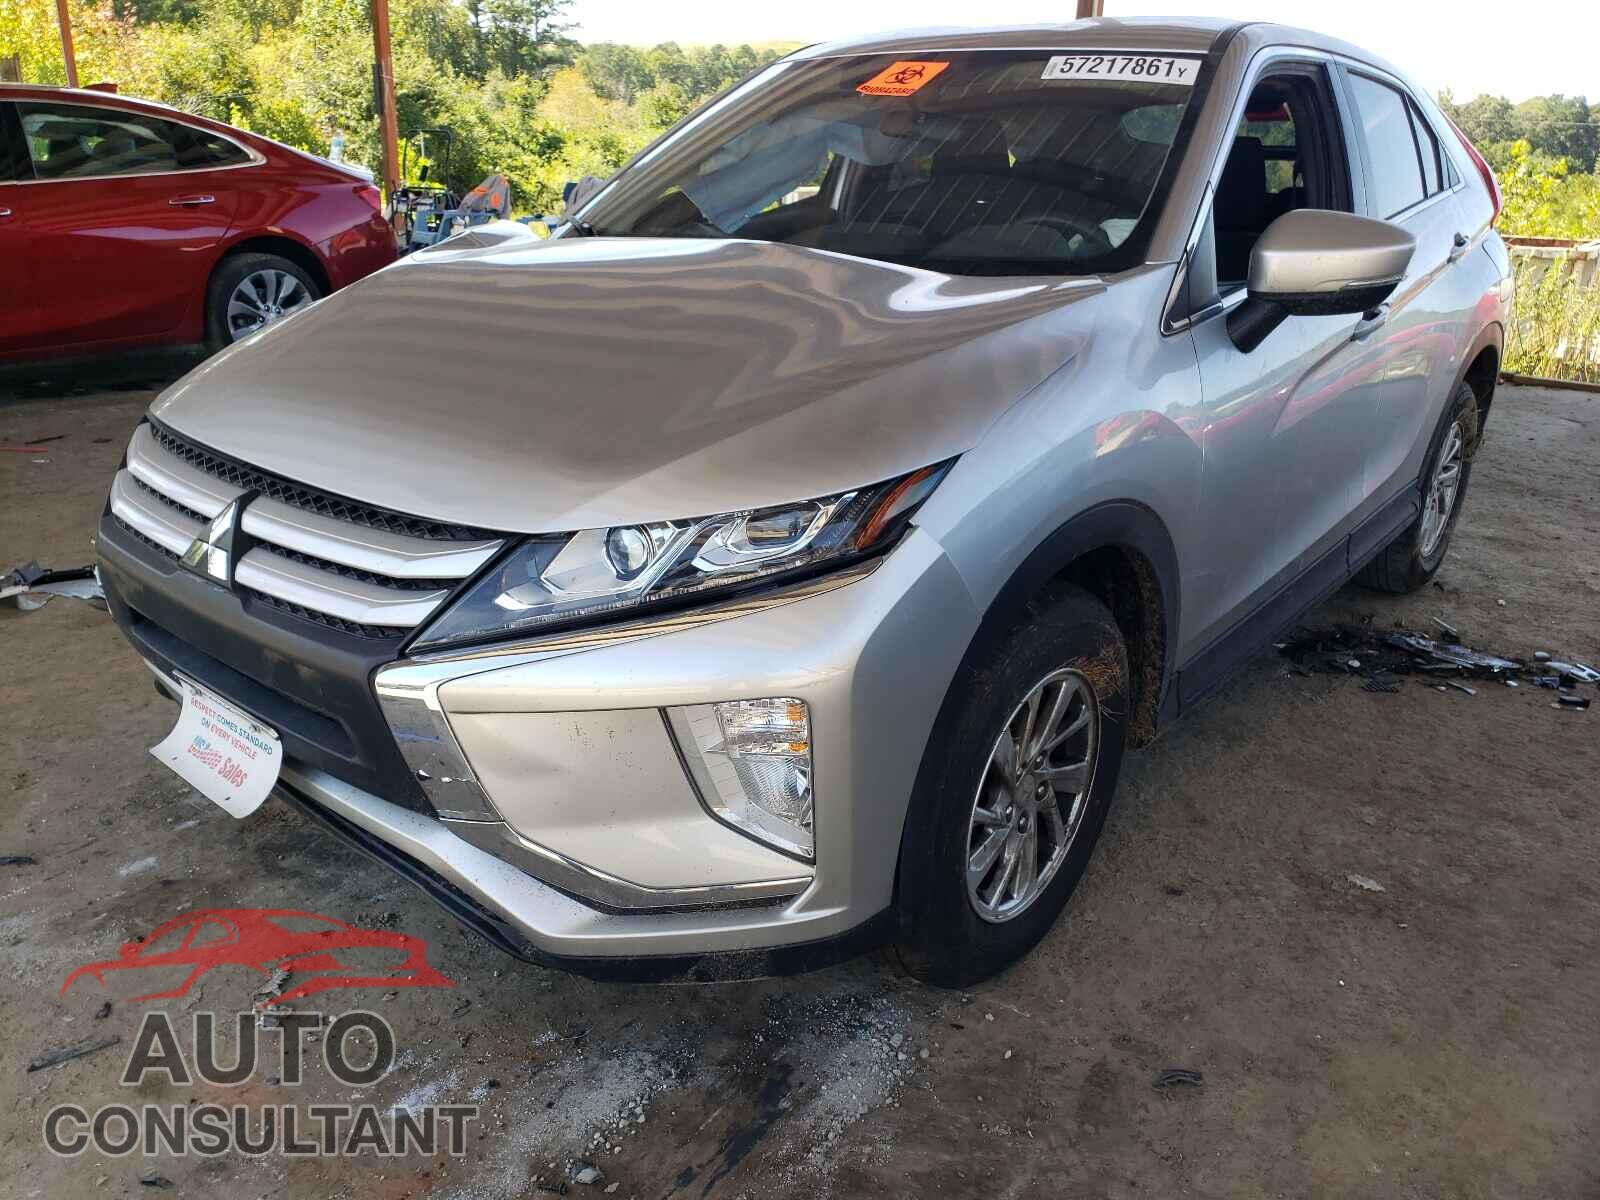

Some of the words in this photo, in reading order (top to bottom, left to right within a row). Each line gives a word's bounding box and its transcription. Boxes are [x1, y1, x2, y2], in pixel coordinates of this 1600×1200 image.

[1059, 56, 1175, 77] 57217861
[1178, 67, 1187, 78] Y
[191, 697, 216, 720] RESPECT
[216, 714, 238, 734] COMES
[239, 729, 273, 756] STANDARD
[201, 717, 210, 728] ON
[210, 724, 231, 742] EVERY
[231, 739, 257, 760] VEHICLE
[217, 757, 248, 788] Sales
